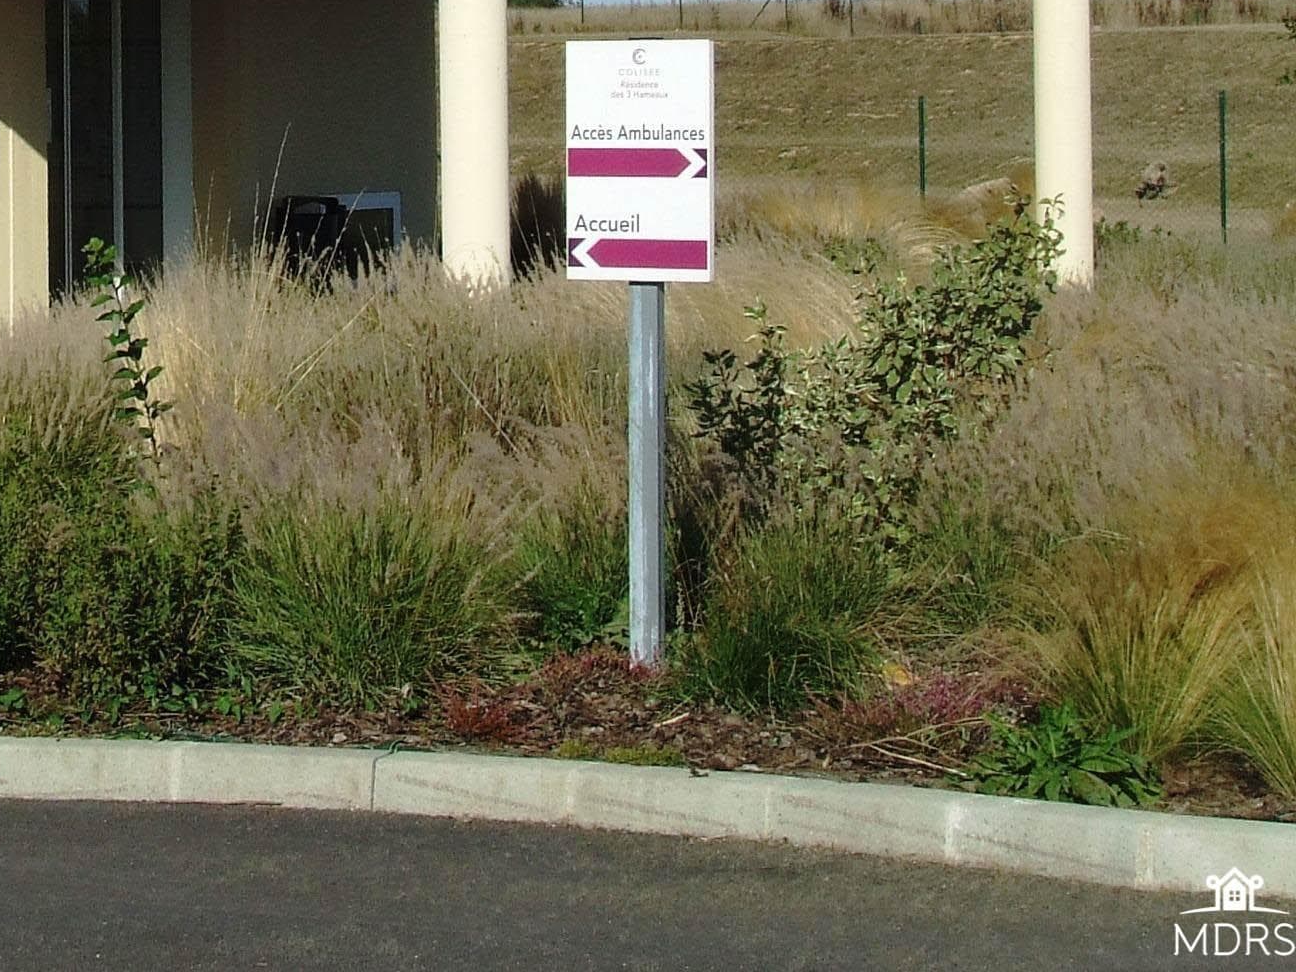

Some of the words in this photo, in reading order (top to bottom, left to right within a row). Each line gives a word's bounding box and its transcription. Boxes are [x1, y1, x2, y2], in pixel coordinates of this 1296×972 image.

[633, 91, 668, 99] Hameaux
[571, 125, 613, 140] Accès
[617, 124, 705, 141] Ambulances
[574, 214, 640, 233] Accueil
